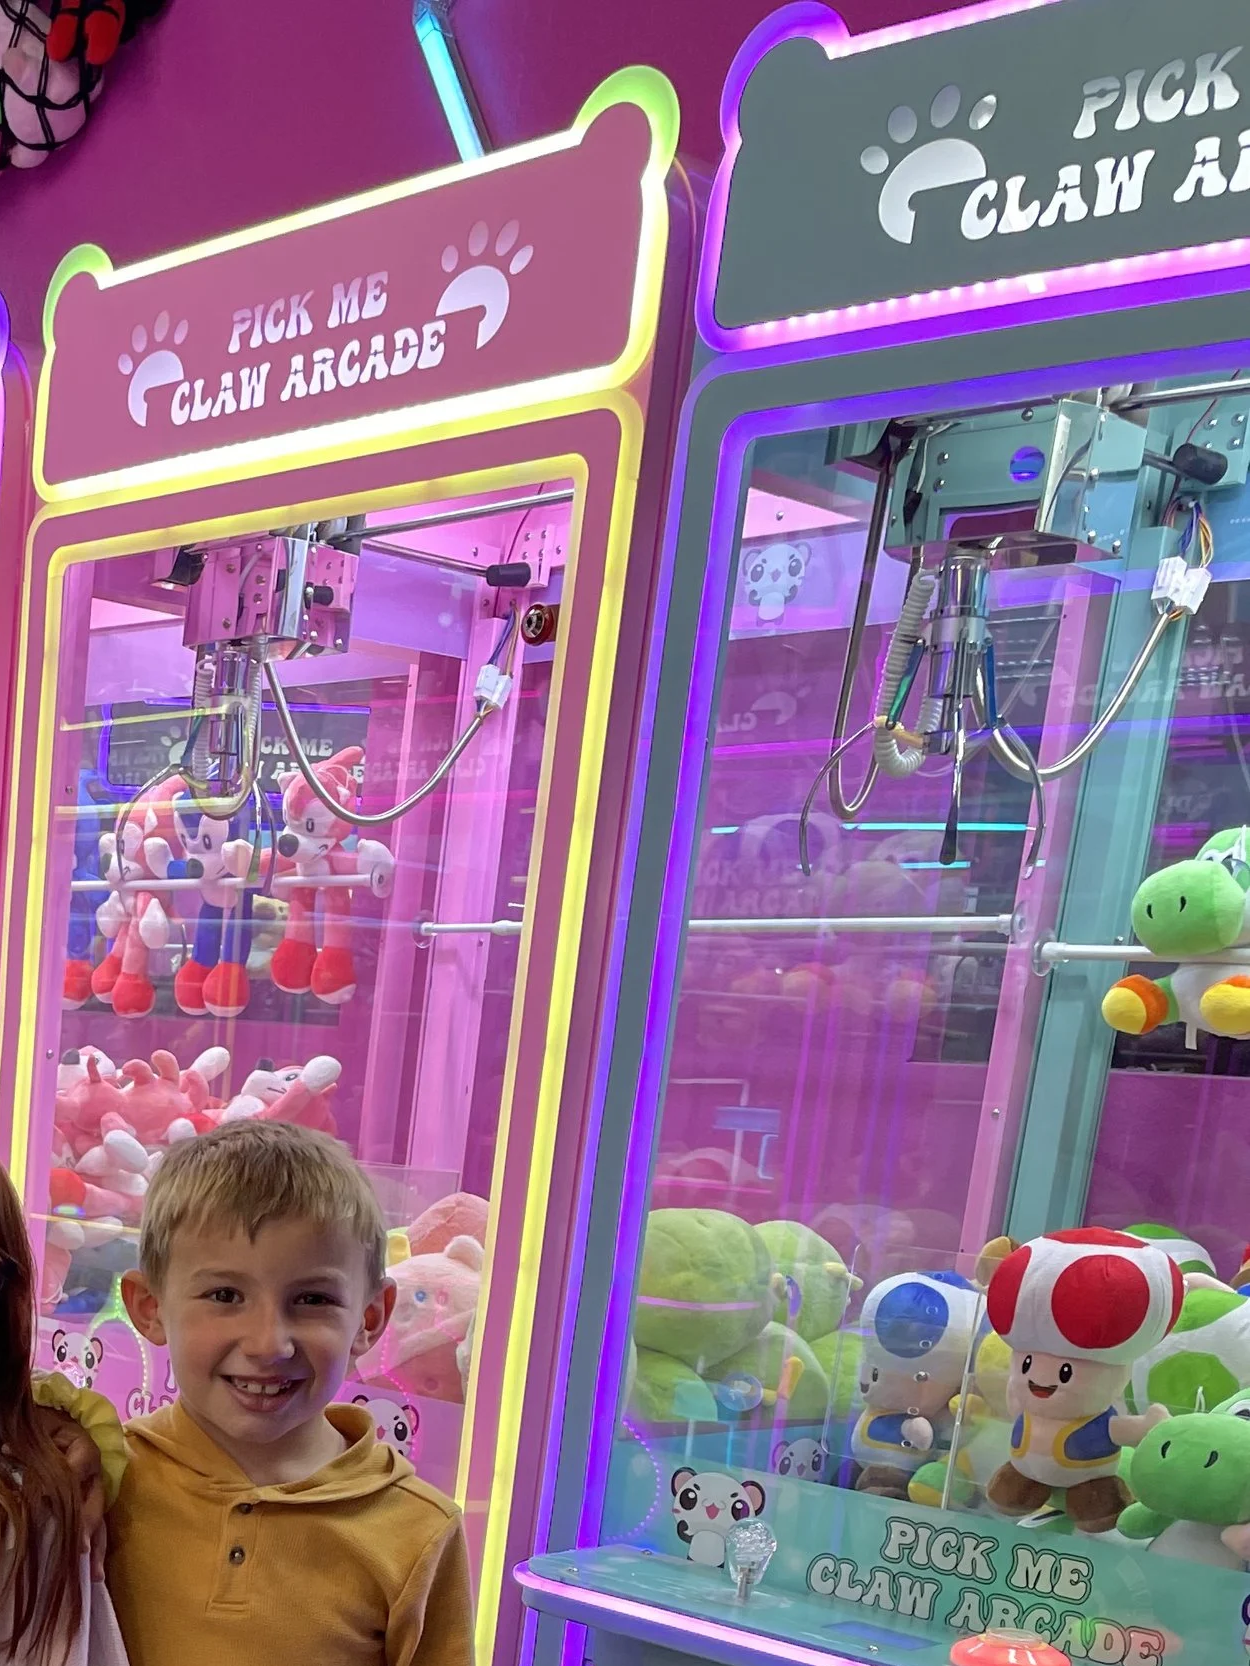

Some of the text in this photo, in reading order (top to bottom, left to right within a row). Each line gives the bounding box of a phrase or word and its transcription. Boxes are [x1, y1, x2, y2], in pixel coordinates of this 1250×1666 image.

[1072, 45, 1244, 140] PICK
[960, 148, 1156, 241] CLAW
[227, 270, 389, 355] PICK ME
[170, 319, 447, 427] CLAW ARCADE
[807, 1554, 941, 1619] CLAW
[882, 1518, 1092, 1603] PICK ME
